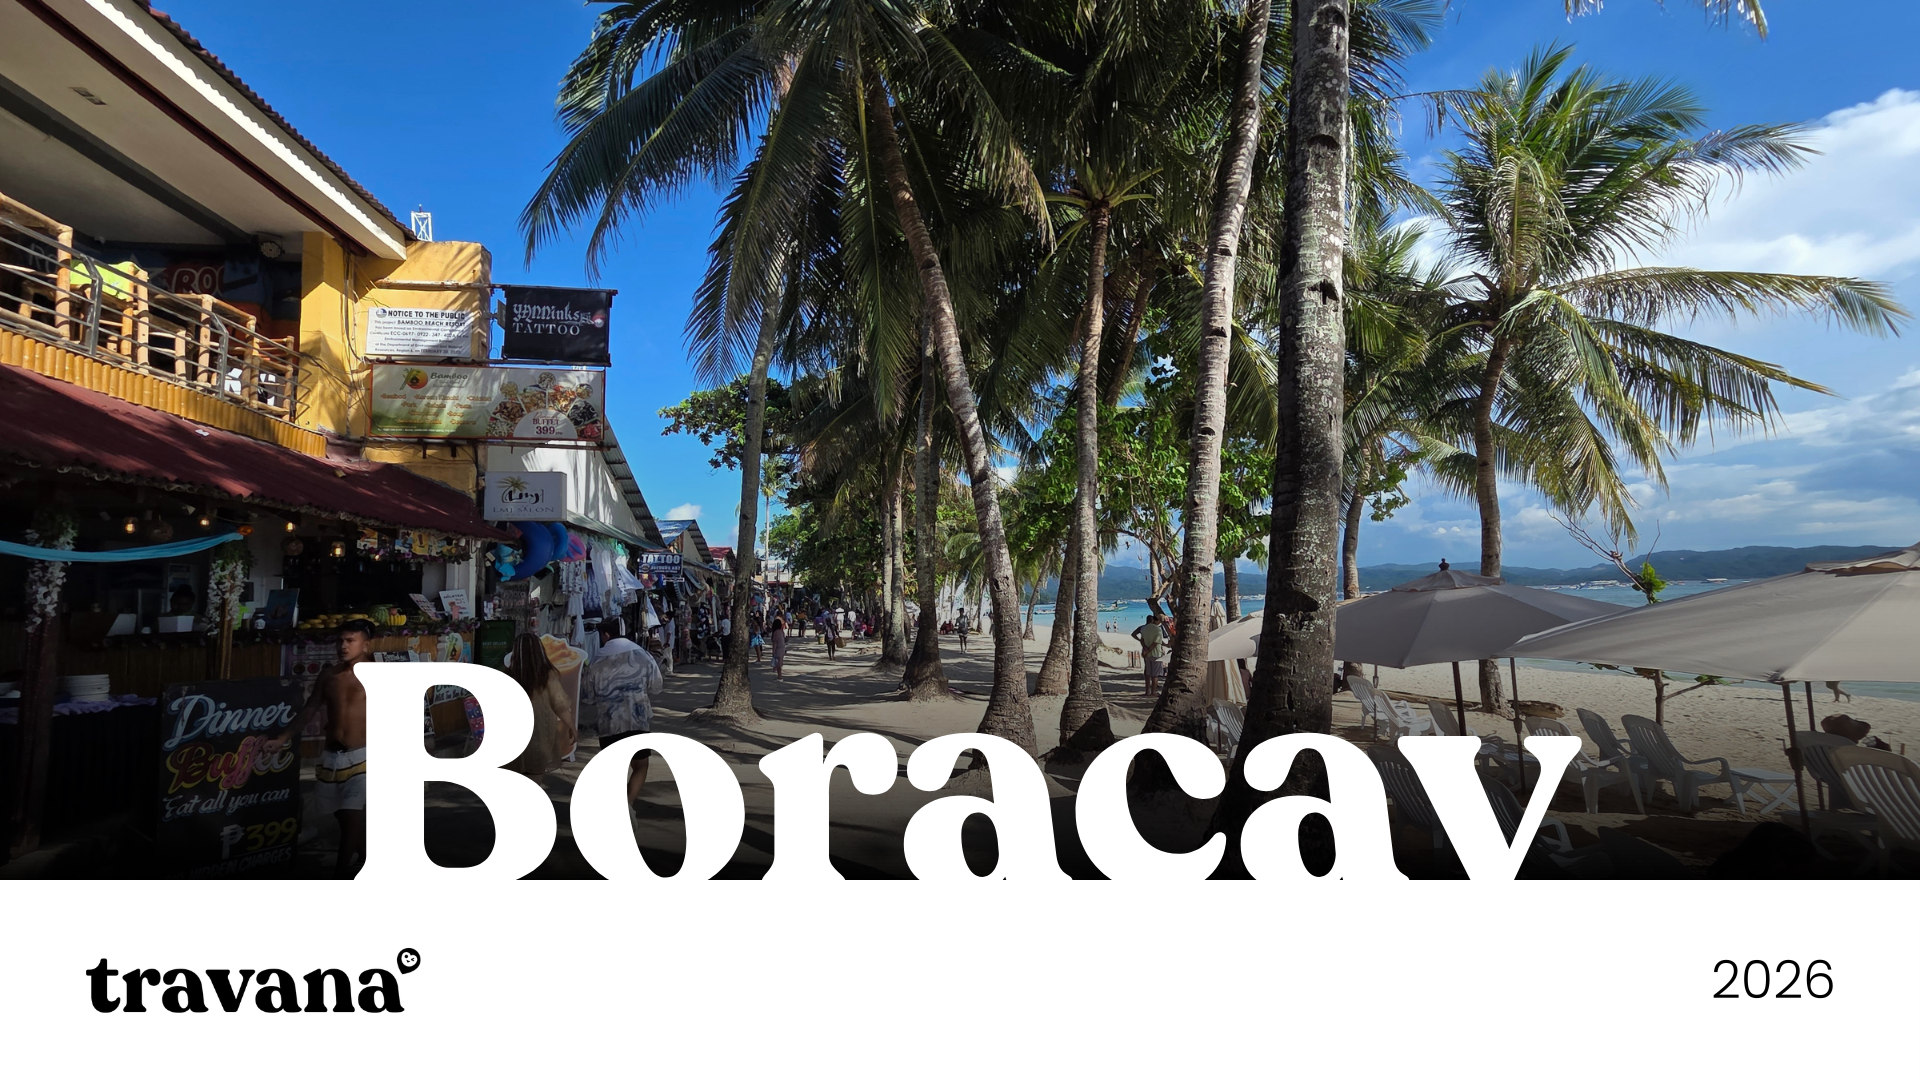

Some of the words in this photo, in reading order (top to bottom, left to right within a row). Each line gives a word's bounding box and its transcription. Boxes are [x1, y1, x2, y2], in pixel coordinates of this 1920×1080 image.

[512, 323, 580, 335] TATTOO
[536, 426, 555, 434] 399
[641, 554, 680, 564] TATTOO
[162, 693, 297, 751] Dinner
[162, 795, 201, 822] Eat
[199, 789, 228, 814] all
[226, 792, 259, 816] you
[260, 788, 290, 803] can
[238, 847, 292, 872] CHARGES
